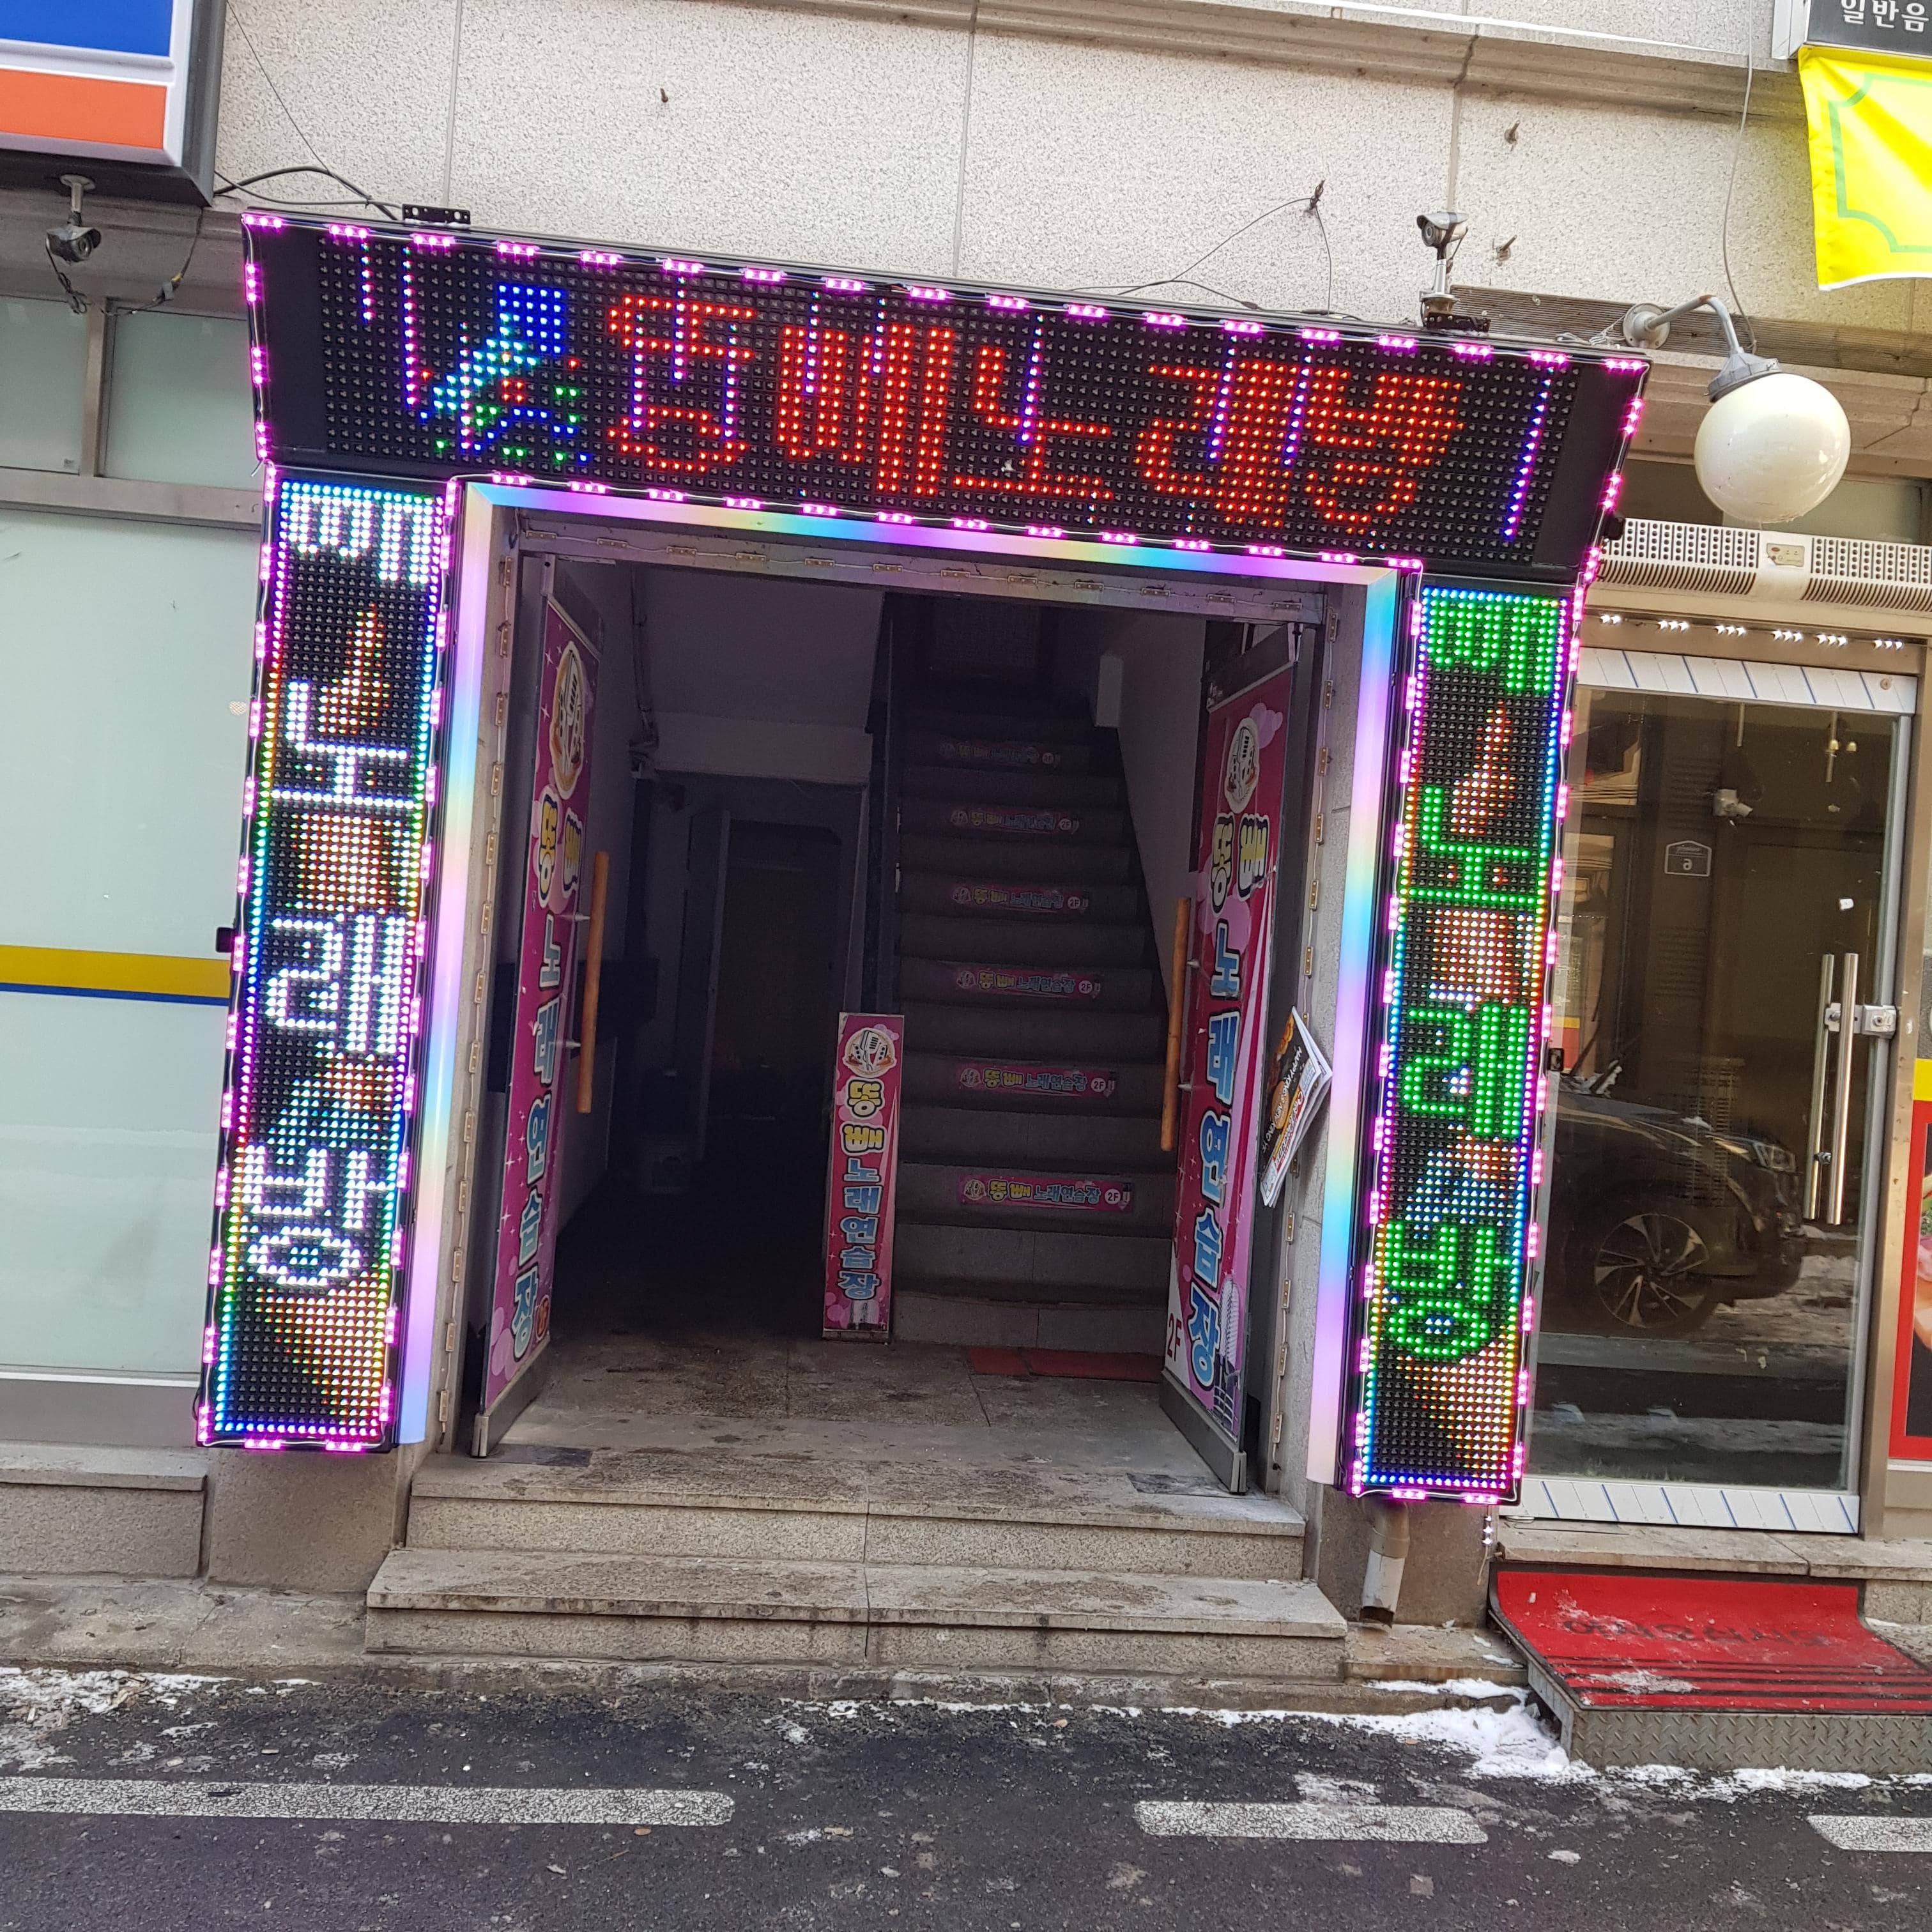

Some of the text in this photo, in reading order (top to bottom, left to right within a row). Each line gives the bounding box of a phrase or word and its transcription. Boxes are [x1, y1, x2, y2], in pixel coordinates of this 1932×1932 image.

[1841, 0, 1929, 33] 일반음
[1025, 1073, 1087, 1092] 노래연습장
[512, 914, 562, 1363] 노래연습장
[1188, 919, 1241, 1391] 노래연습장
[1034, 1184, 1101, 1204] 노래연습장
[1107, 1192, 1119, 1202] 2F
[839, 1158, 883, 1301] 노래연습장
[1166, 1312, 1183, 1369] 2F
